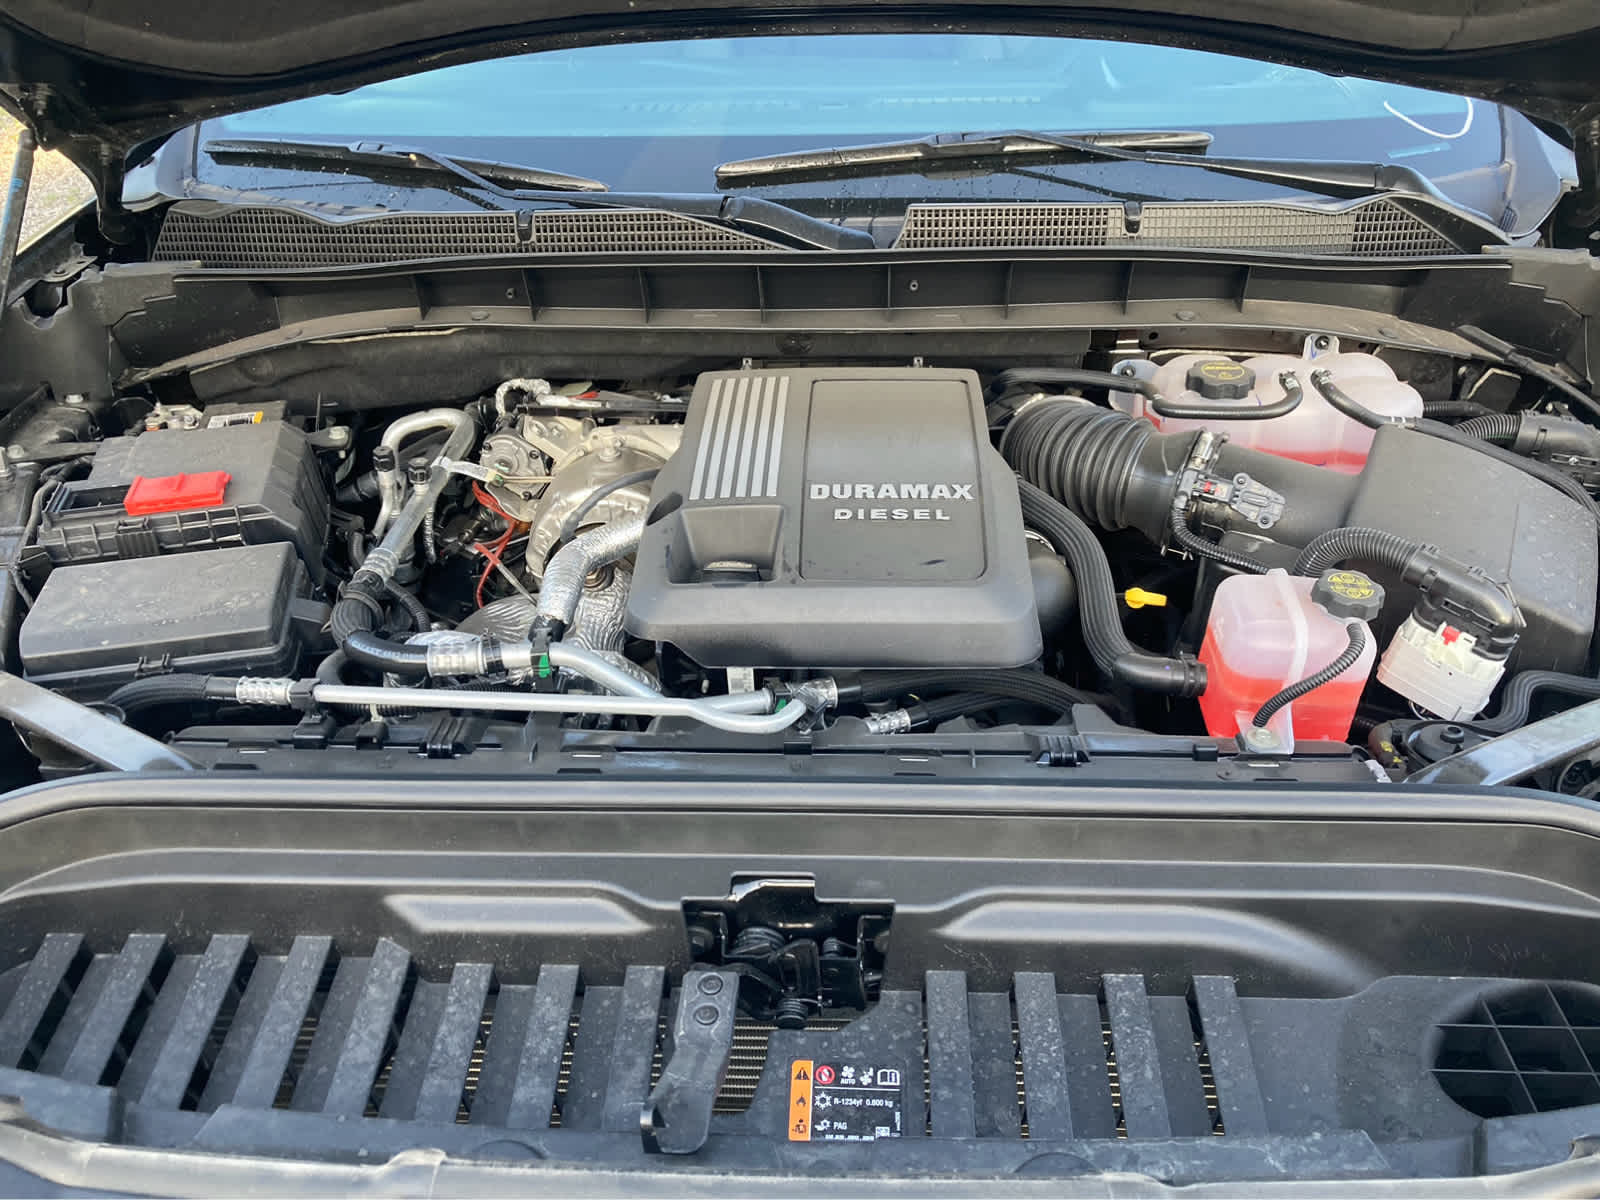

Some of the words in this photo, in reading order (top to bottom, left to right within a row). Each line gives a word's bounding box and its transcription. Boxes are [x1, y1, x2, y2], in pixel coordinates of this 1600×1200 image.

[810, 483, 974, 500] DURAMAX
[834, 508, 951, 521] DIESEL
[834, 1098, 863, 1108] R-1234yf
[885, 1099, 894, 1108] kg
[833, 1122, 847, 1130] PAG
